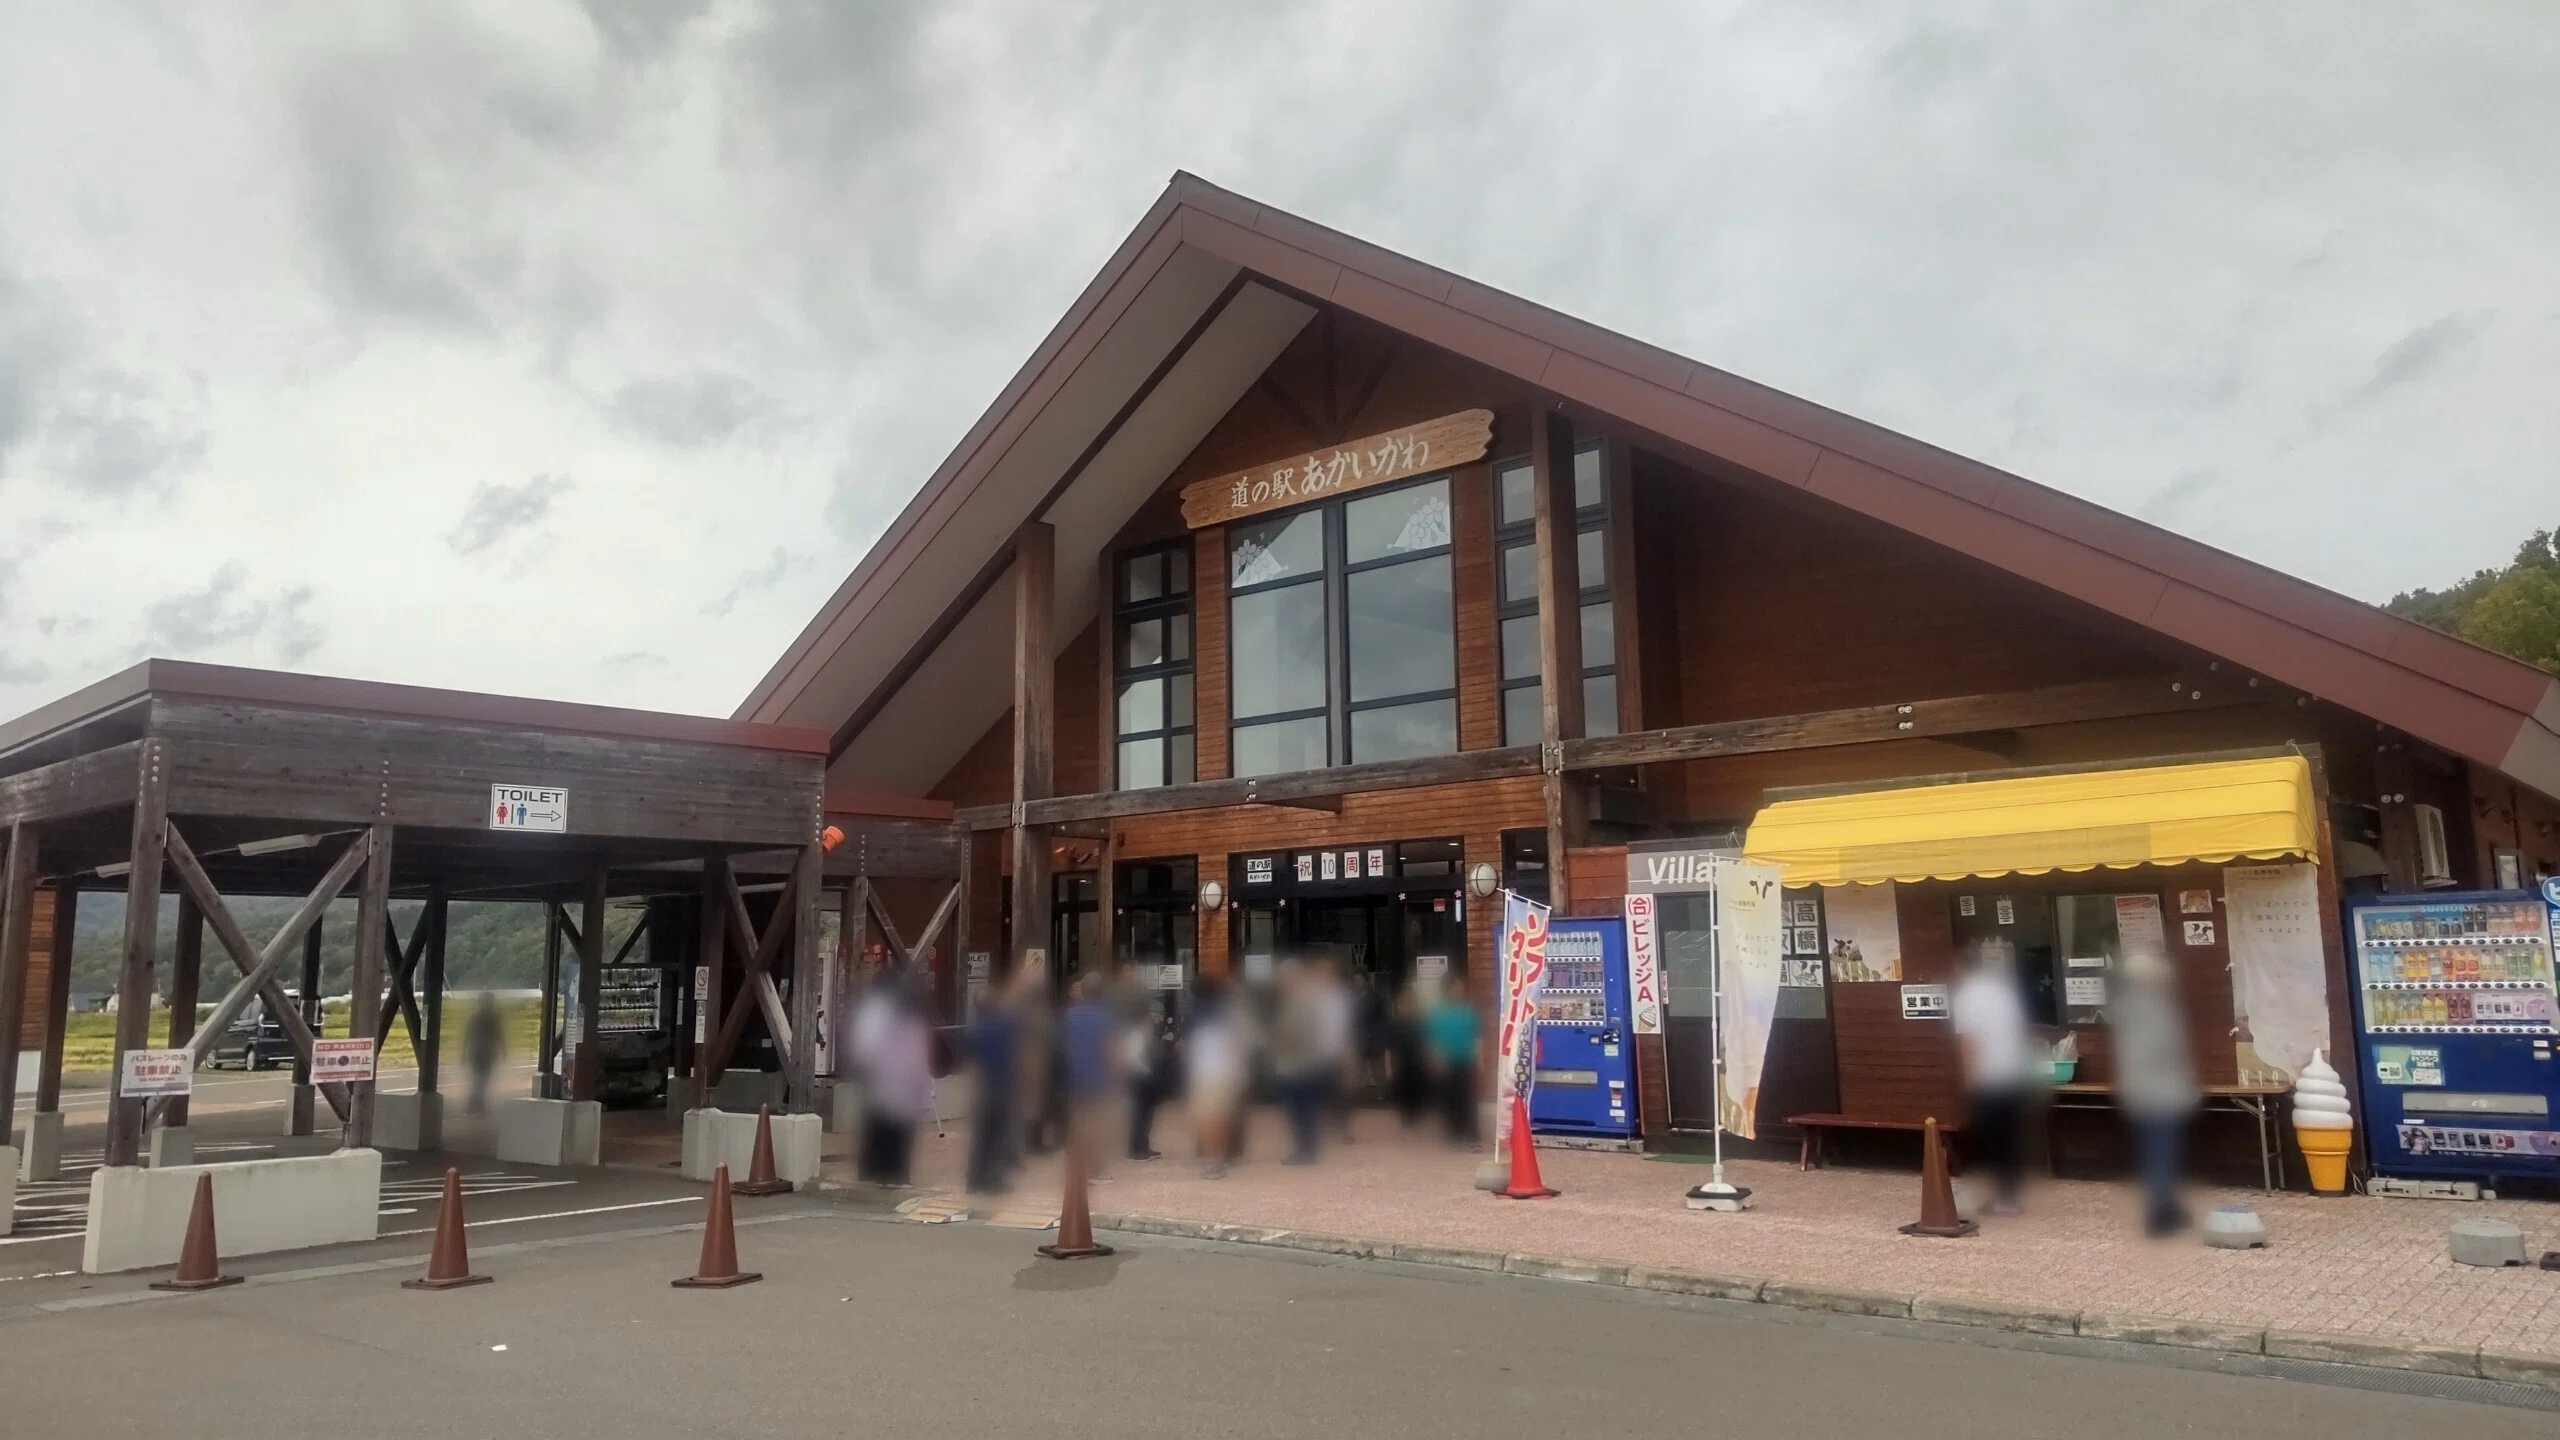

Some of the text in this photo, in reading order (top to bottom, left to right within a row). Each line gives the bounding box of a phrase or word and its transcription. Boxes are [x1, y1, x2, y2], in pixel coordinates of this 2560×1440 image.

[497, 789, 563, 803] TOILET
[1248, 860, 1271, 870] 道の駅
[2420, 904, 2473, 913] SUNTORY
[1907, 996, 1944, 1008] 営業中
[334, 1042, 370, 1050] PARKING
[134, 1065, 182, 1076] 駐車禁止
